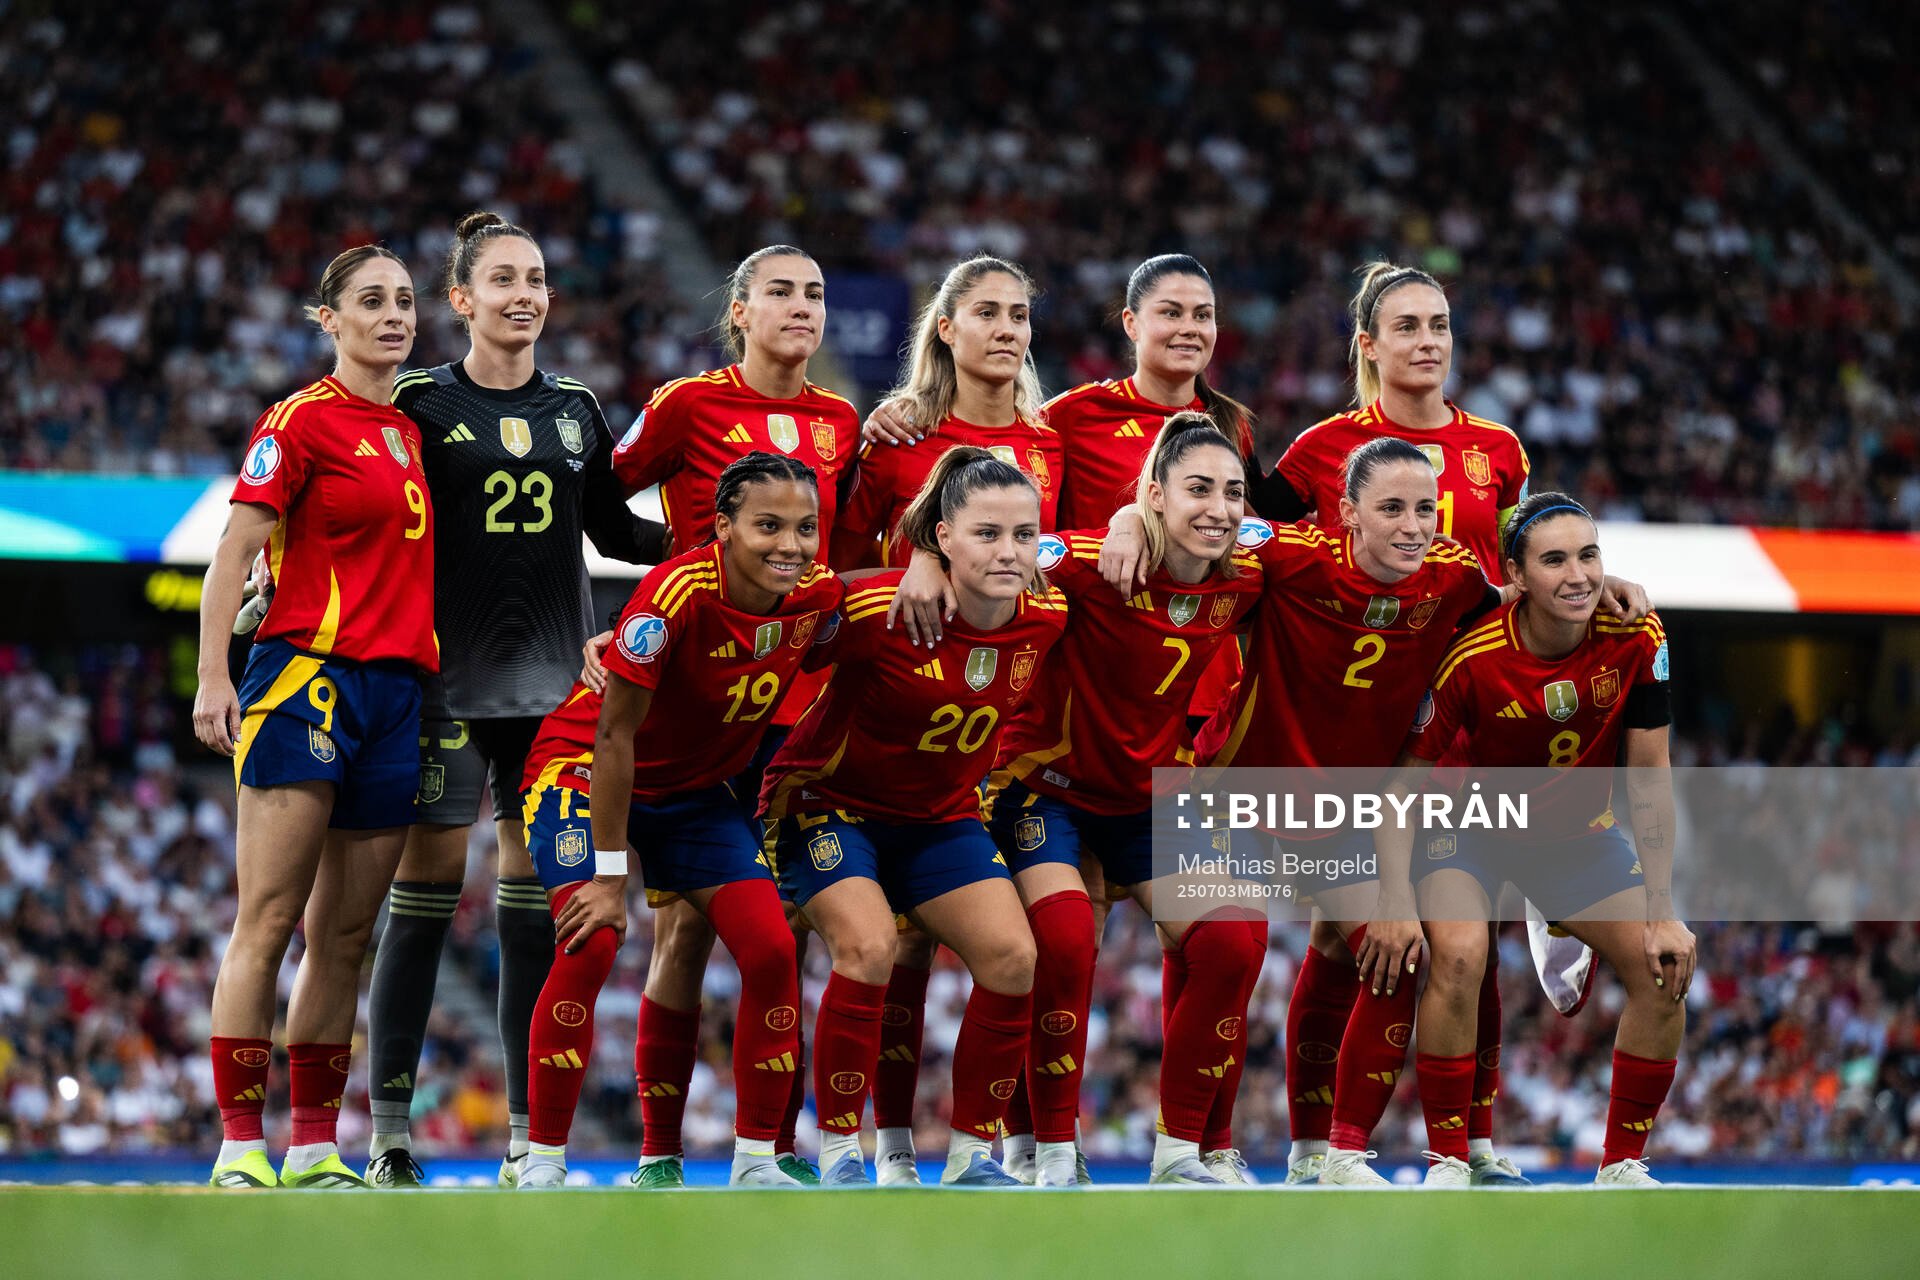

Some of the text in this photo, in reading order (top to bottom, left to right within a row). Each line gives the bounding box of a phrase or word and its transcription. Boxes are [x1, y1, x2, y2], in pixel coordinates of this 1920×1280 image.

[404, 479, 426, 540] 9
[484, 470, 553, 533] 23
[1154, 637, 1191, 695] 7
[1343, 633, 1387, 689] 2
[308, 677, 338, 733] 9
[722, 671, 780, 723] 19
[917, 703, 999, 754] 20
[1548, 730, 1580, 773] 8
